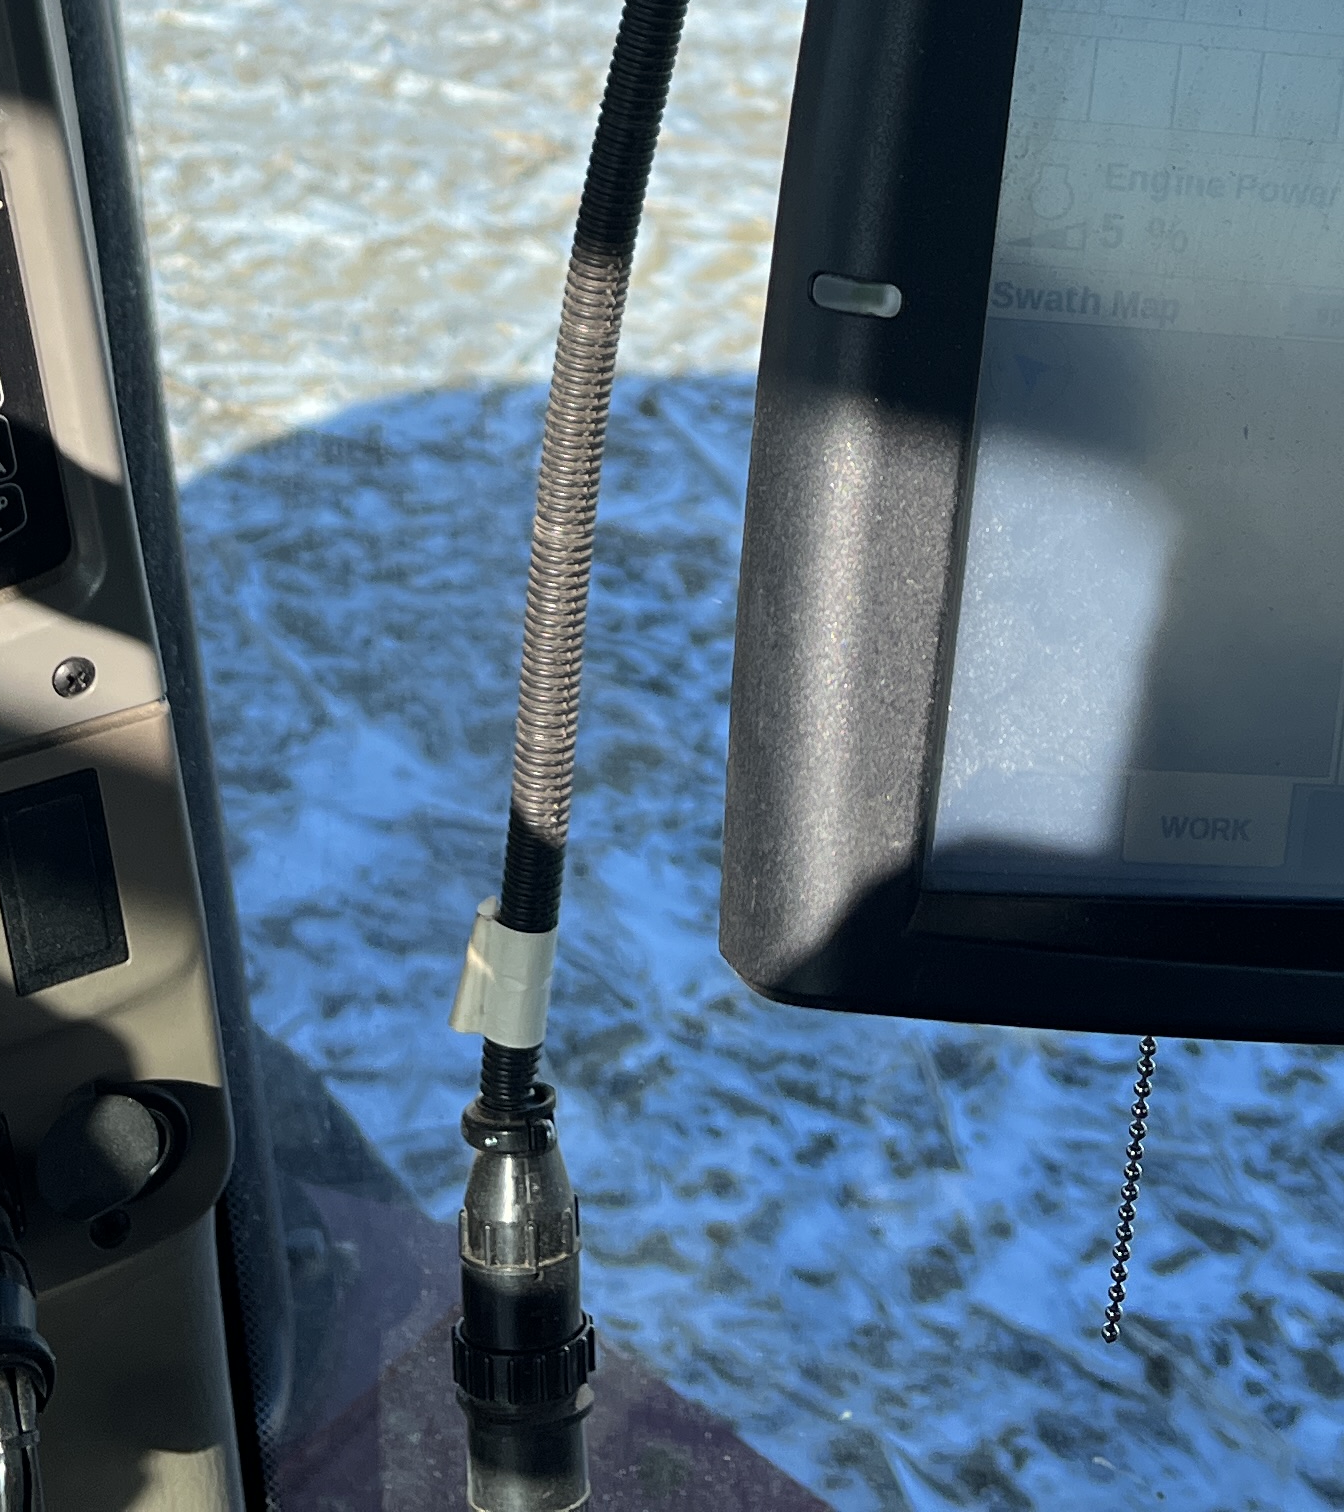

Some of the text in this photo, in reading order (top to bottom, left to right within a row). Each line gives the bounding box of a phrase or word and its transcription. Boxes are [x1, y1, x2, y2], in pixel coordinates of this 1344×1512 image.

[1105, 163, 1343, 210] Engine Power
[1101, 213, 1125, 249] 5
[990, 281, 1179, 326] Swath Map
[1160, 814, 1253, 844] WORK
